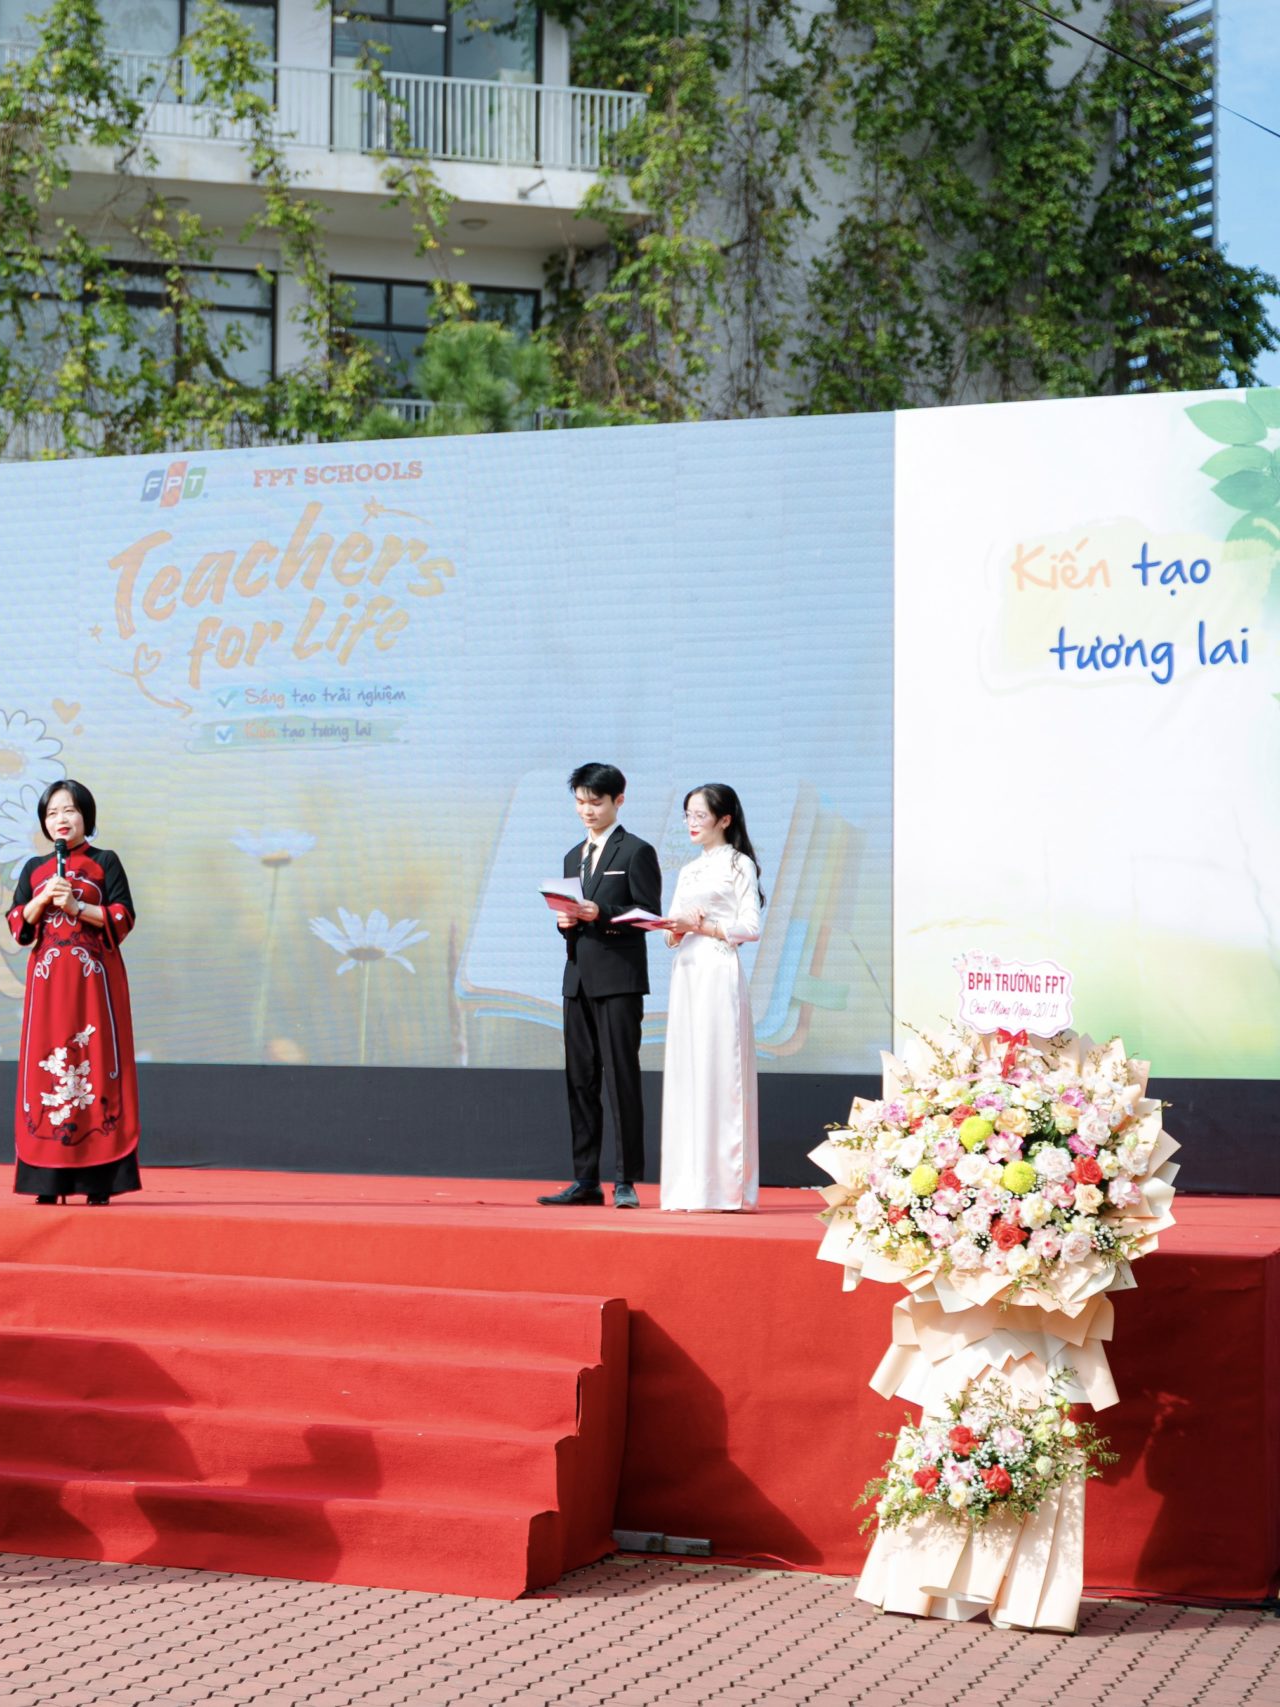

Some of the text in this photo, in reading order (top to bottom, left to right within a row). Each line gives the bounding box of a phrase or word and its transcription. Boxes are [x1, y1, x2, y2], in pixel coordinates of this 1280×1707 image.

[253, 460, 423, 487] FPT SCHOOLS
[107, 501, 456, 640] Teachers
[1011, 537, 1211, 596] Kiến tạo
[187, 593, 410, 689] for Life
[1049, 620, 1249, 685] tương lai
[244, 685, 407, 709] Sáng tạo trải nghiệm
[281, 722, 305, 742] tạo
[355, 720, 373, 737] lai
[968, 969, 1065, 994] BPH TRƯỜNG FPT
